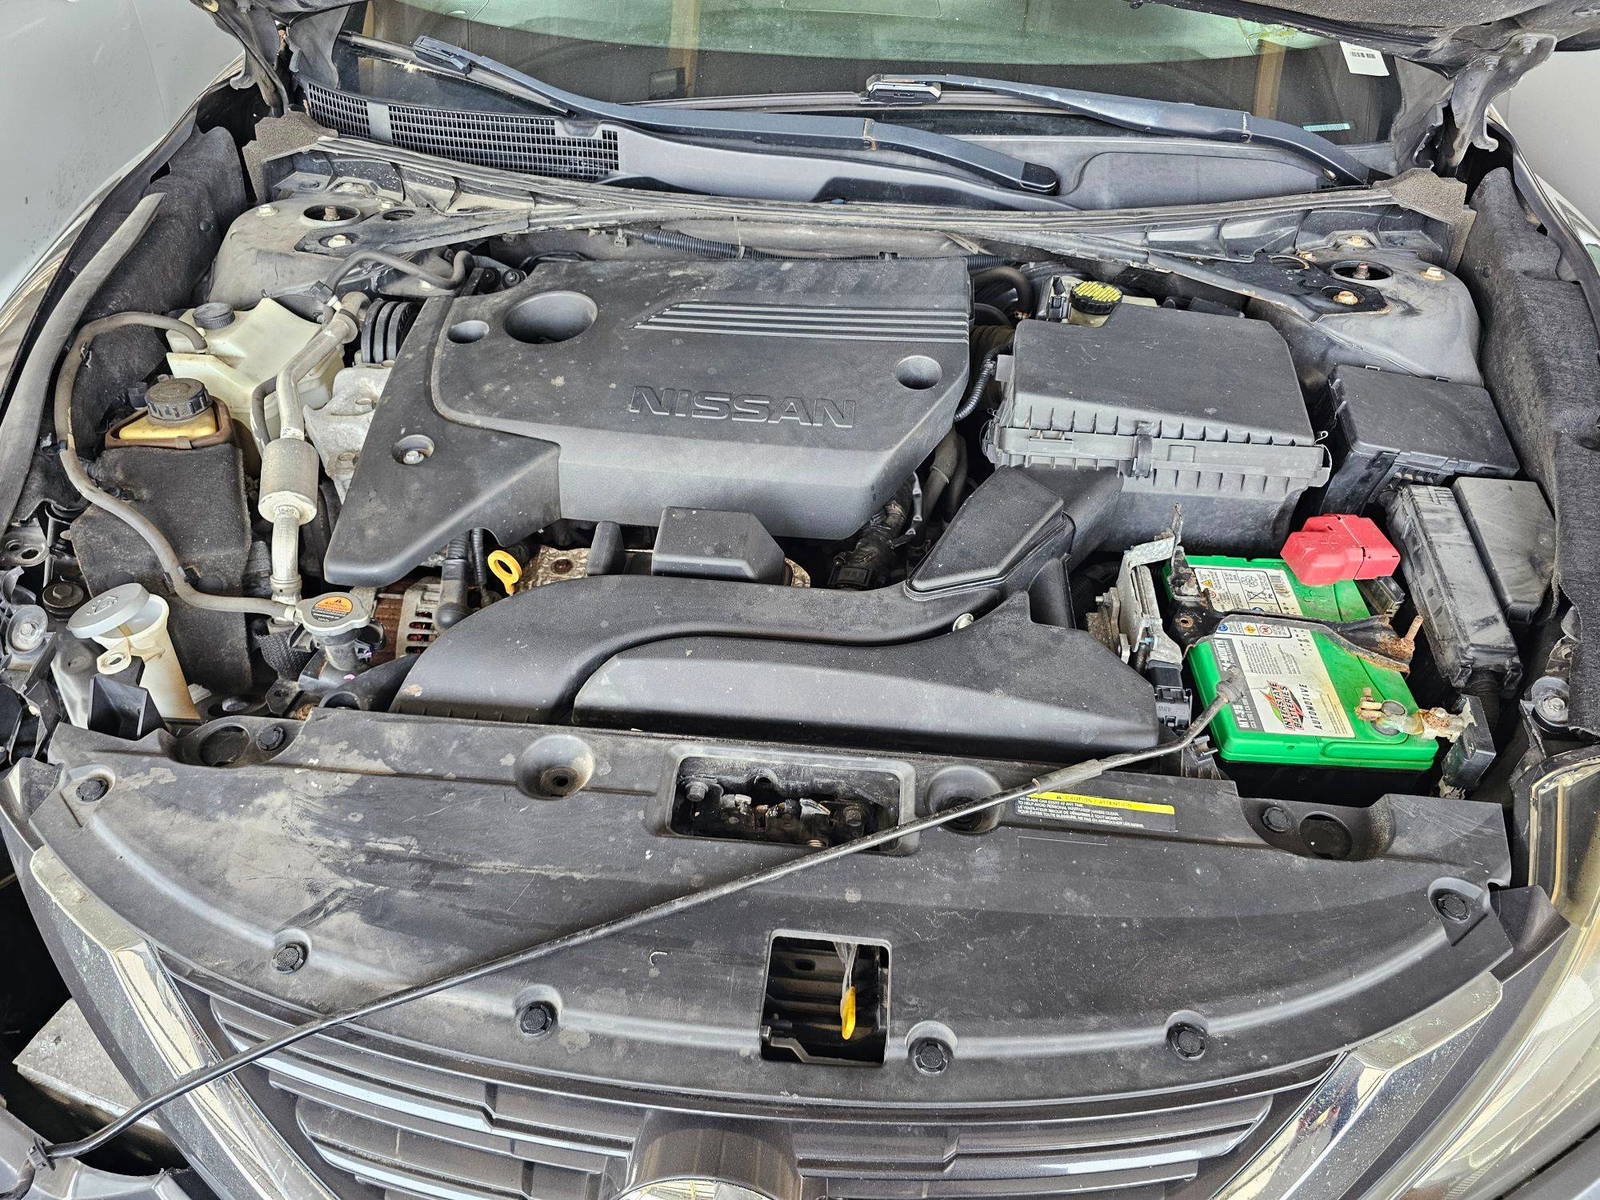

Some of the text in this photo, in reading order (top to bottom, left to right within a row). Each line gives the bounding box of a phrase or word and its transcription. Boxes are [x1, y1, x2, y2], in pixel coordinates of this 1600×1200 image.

[629, 385, 856, 428] NISSAN
[1269, 680, 1294, 730] INTERSTATE
[1281, 685, 1303, 730] BATTERIES
[1298, 683, 1323, 730] AUTOMOTIVE
